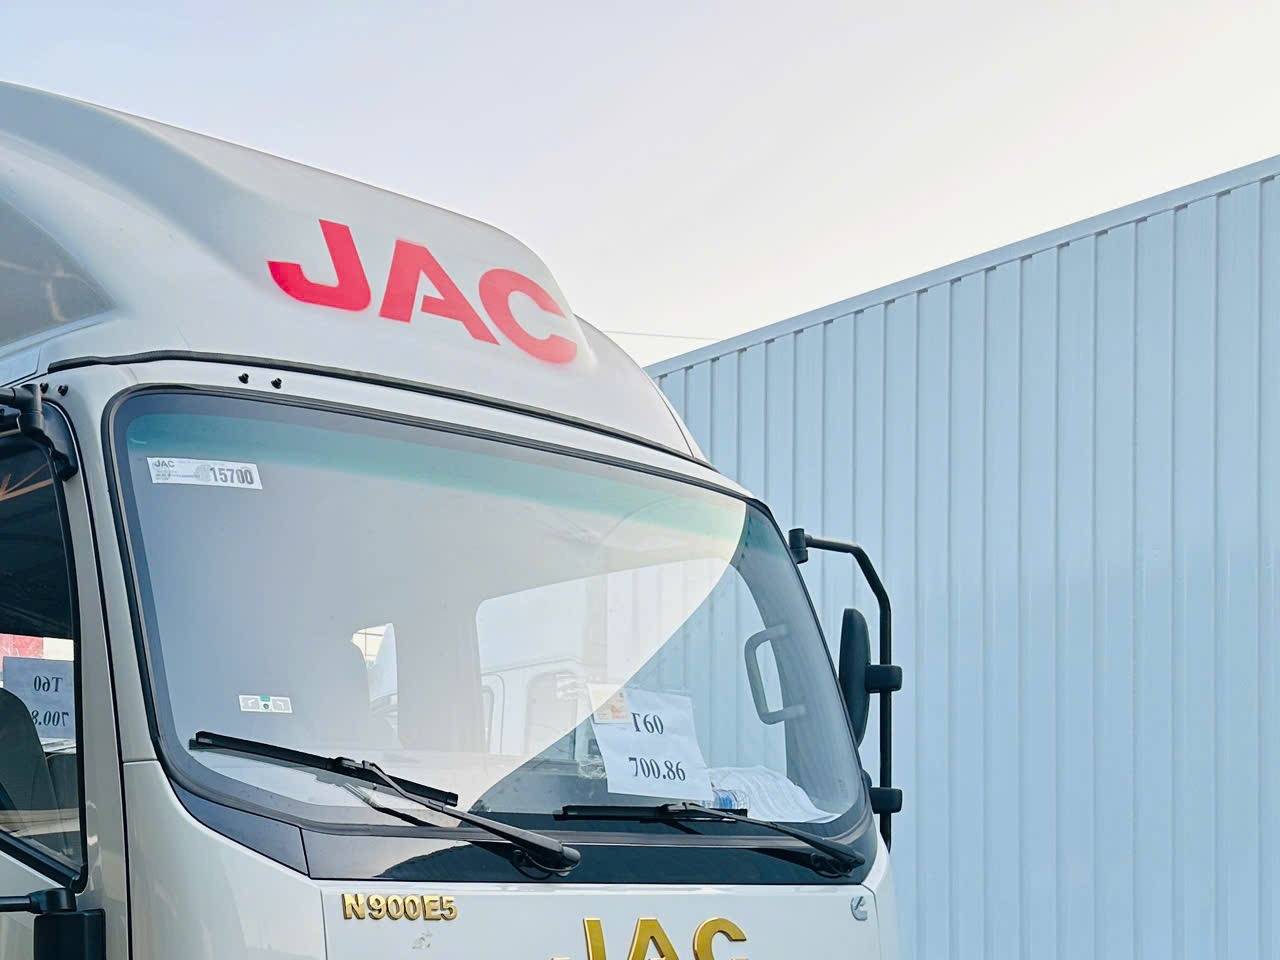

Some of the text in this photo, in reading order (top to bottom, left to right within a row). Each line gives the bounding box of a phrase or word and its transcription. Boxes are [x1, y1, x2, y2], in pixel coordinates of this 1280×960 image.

[267, 218, 578, 365] JAC
[154, 460, 175, 468] JAC
[210, 466, 255, 485] 15700
[628, 757, 686, 782] 700.86
[342, 893, 458, 921] N900E5
